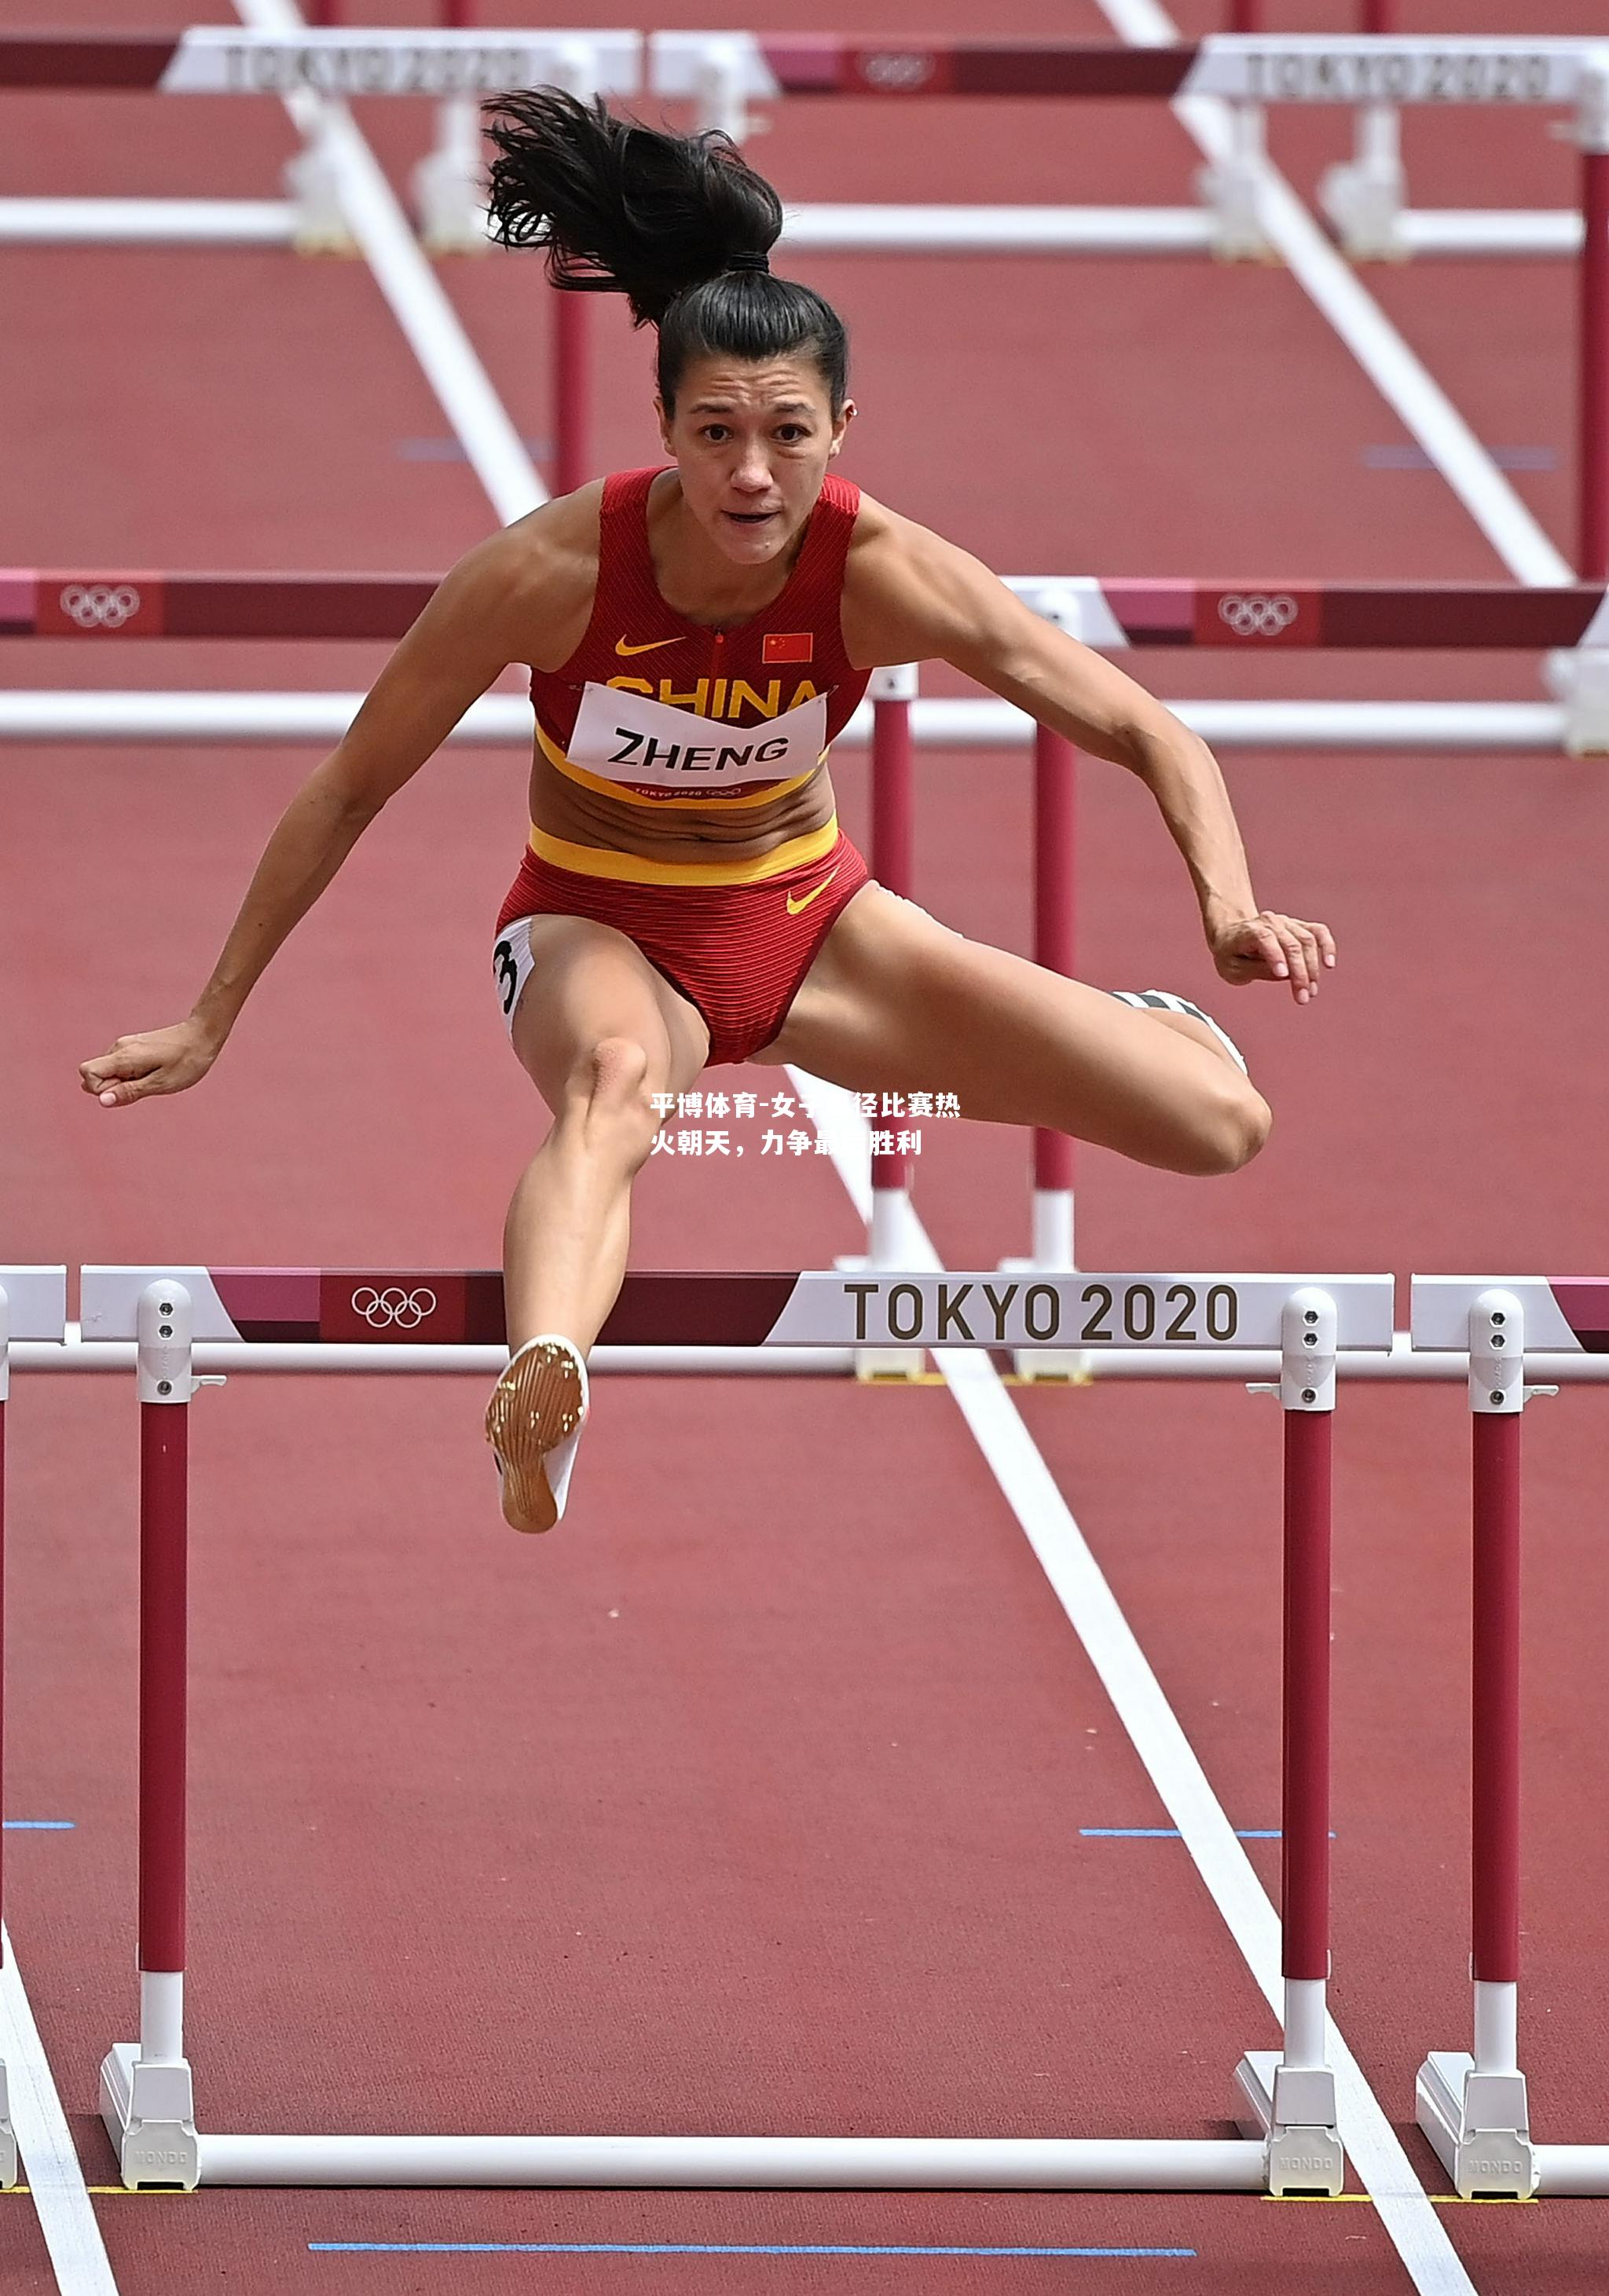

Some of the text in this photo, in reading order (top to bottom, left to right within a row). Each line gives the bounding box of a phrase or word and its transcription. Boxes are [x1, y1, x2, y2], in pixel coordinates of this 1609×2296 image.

[225, 47, 531, 93] TOKYO 2020
[1245, 53, 1552, 101] TOKYO 2020
[608, 727, 790, 771] ZHENG
[635, 788, 672, 797] TOKYO
[493, 940, 517, 1014] 3
[844, 1283, 1239, 1341] TOKYO 2020
[1279, 2157, 1333, 2171] MONDO
